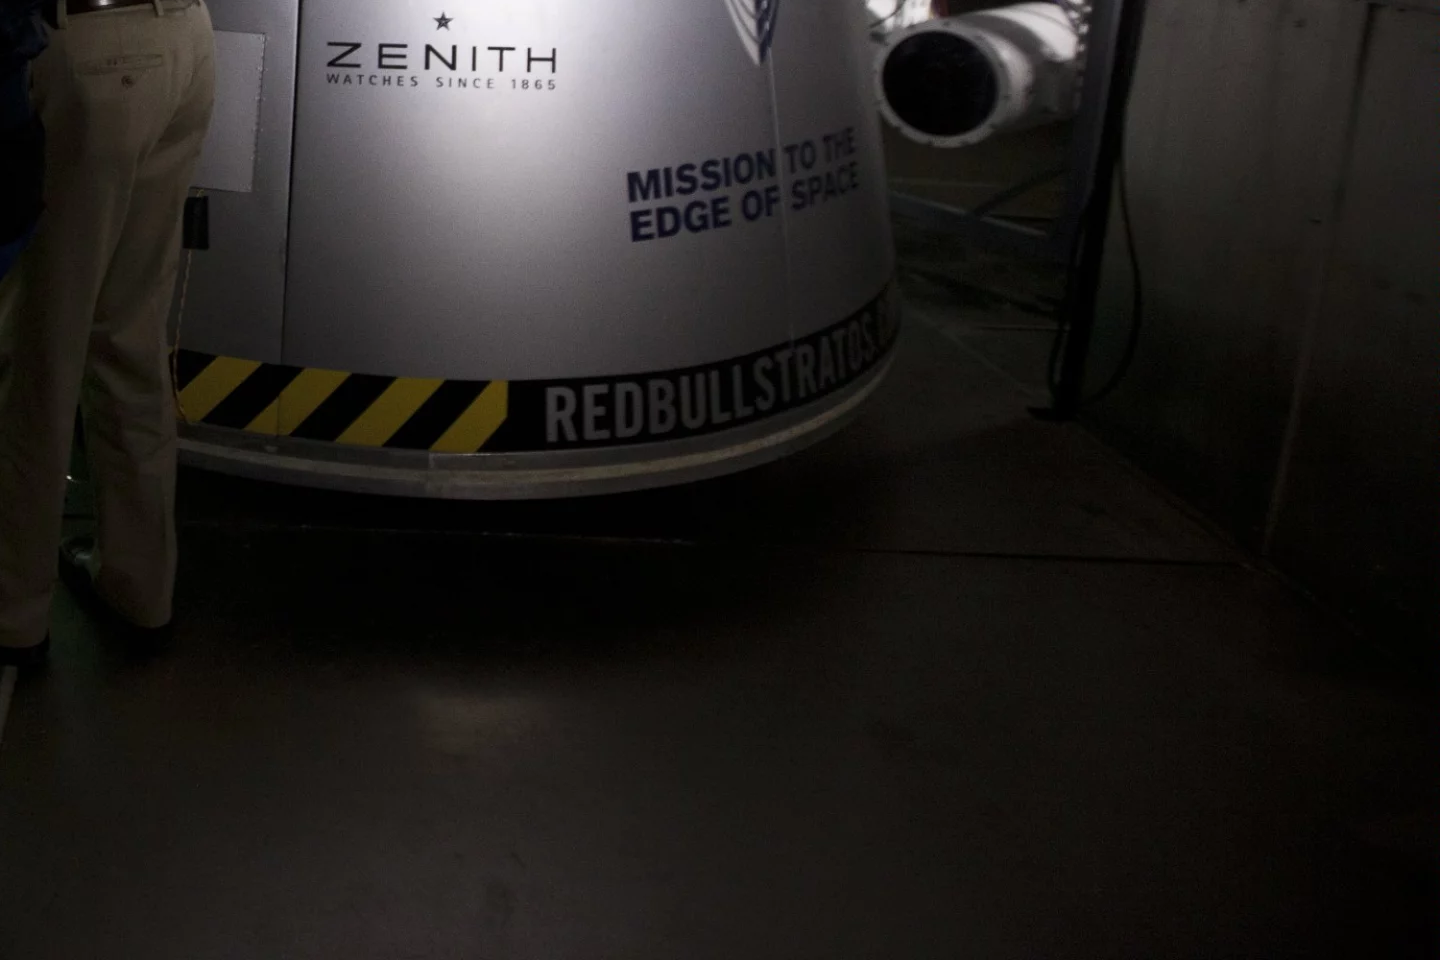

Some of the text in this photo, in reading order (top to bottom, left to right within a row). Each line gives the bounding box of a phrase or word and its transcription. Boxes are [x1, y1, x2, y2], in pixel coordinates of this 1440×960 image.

[326, 41, 557, 74] ZENITH
[326, 73, 557, 91] WATCHES SINCE 1865
[626, 126, 856, 204] MISSION TO THE
[629, 160, 860, 243] EDGE OF SPACE
